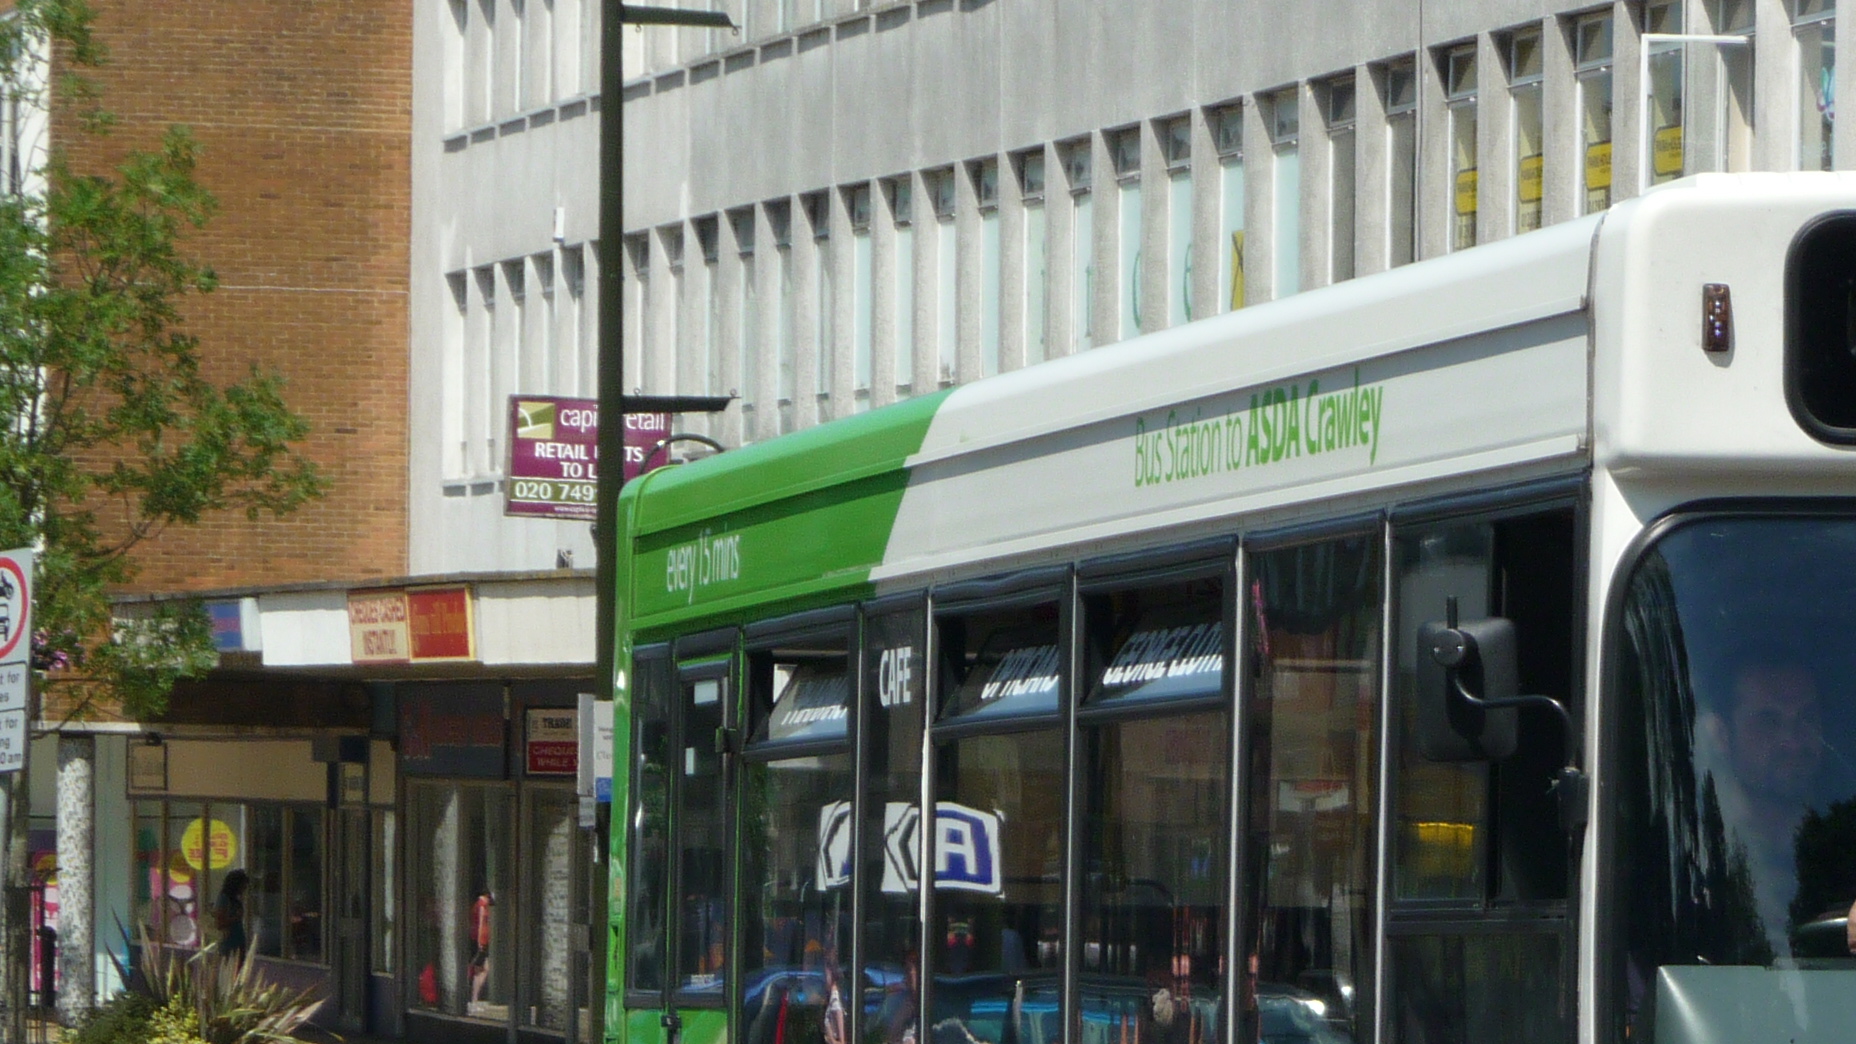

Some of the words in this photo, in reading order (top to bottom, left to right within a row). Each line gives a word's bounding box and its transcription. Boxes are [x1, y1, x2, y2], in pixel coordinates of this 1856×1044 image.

[1134, 416, 1162, 488] Bus
[1165, 406, 1221, 482] Station
[1225, 408, 1242, 471] to
[1245, 384, 1302, 468] ASDA
[1305, 367, 1383, 467] Crawley
[534, 441, 588, 460] RETAIL
[560, 461, 583, 478] TO
[514, 480, 552, 500] 020
[558, 484, 597, 502] 749
[666, 544, 697, 606] every
[699, 527, 711, 586] 15
[712, 522, 740, 581] mins
[879, 646, 912, 707] CAFE
